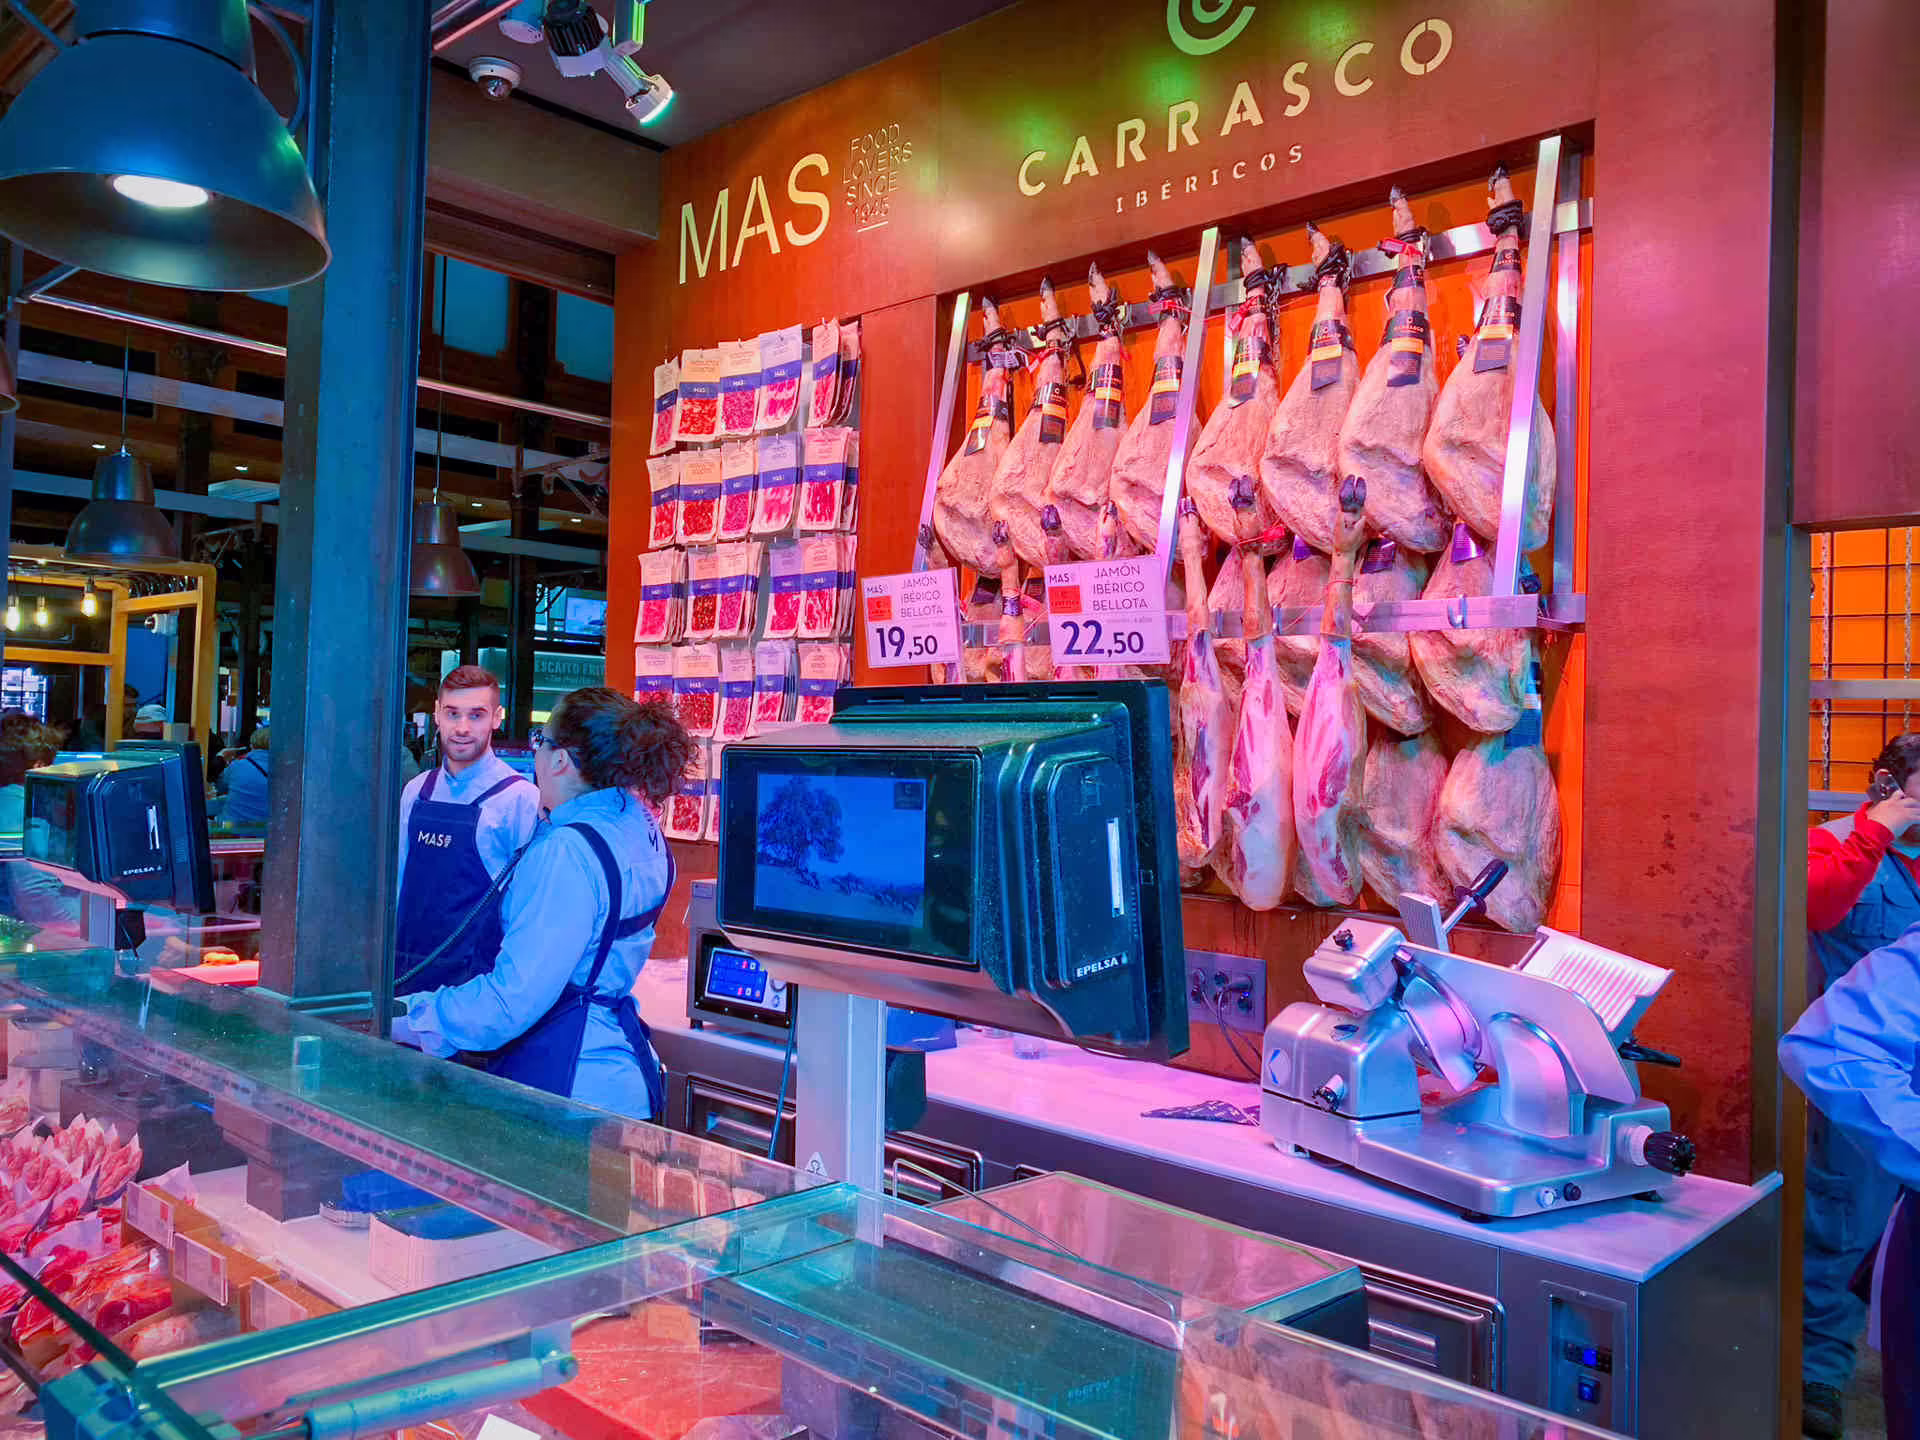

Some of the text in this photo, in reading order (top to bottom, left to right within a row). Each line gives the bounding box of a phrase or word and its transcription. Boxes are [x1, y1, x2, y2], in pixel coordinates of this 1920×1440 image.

[1018, 18, 1454, 197] CARRASCO
[850, 123, 900, 160] FOOD
[842, 142, 913, 184] LOVERS
[846, 170, 898, 206] SINCE
[678, 152, 831, 285] MAS
[1049, 573, 1070, 584] MAS
[1094, 561, 1141, 578] JAMÓN
[901, 575, 938, 589] JAMÓN
[900, 604, 944, 618] BELLOTA
[1092, 598, 1149, 611] BELLOTA
[875, 625, 939, 660] 19,50
[1060, 619, 1145, 658] 22,50
[417, 830, 444, 848] MAS
[123, 866, 155, 876] EPELSA
[1076, 957, 1119, 978] EPELSA
